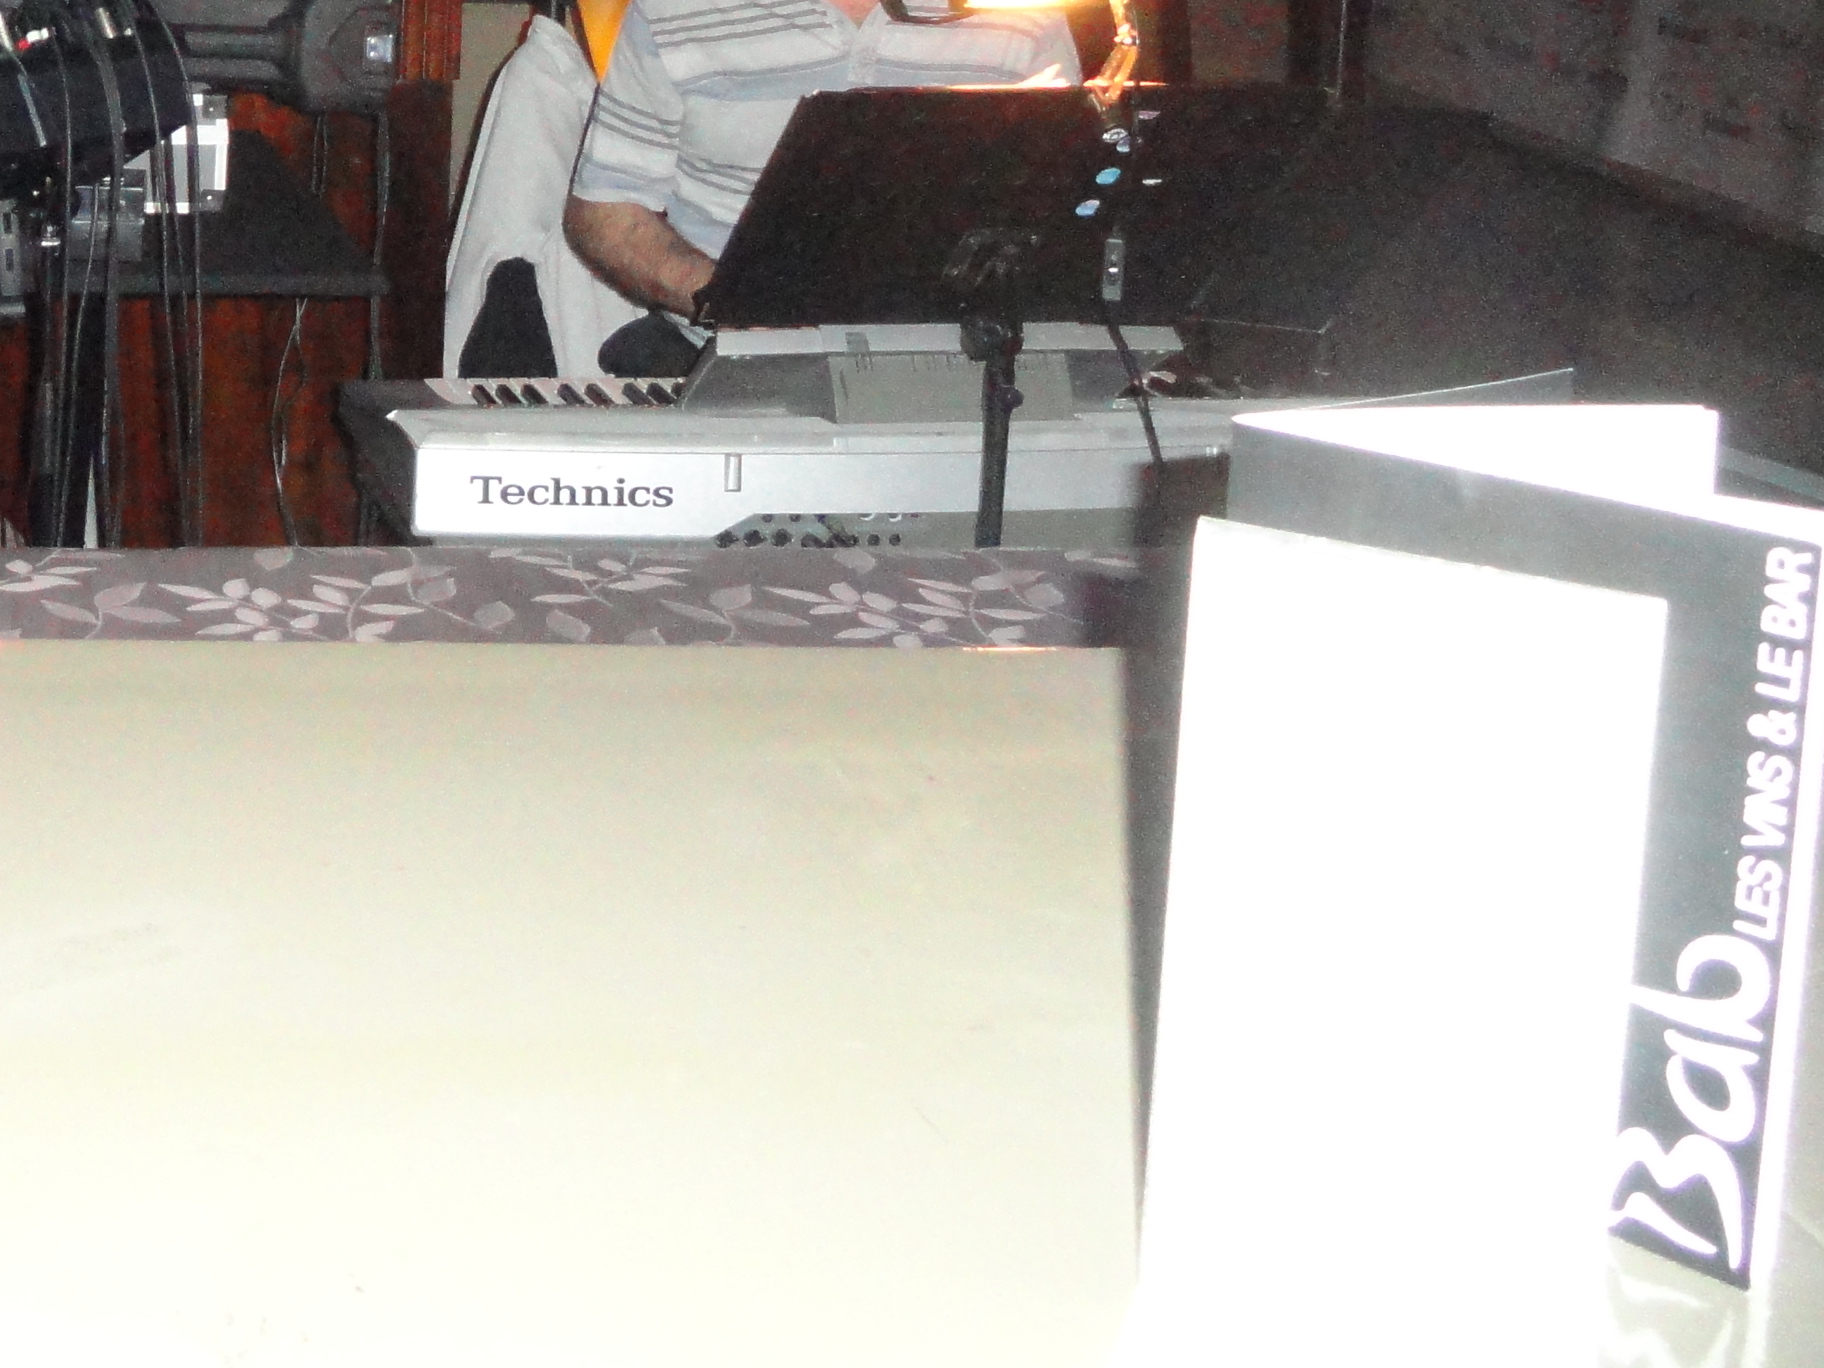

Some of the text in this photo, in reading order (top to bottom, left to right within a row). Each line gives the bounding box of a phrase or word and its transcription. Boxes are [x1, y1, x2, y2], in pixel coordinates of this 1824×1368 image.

[469, 475, 675, 508] Technics
[1608, 546, 1814, 1271] Bab LES VINS & LE BAR
